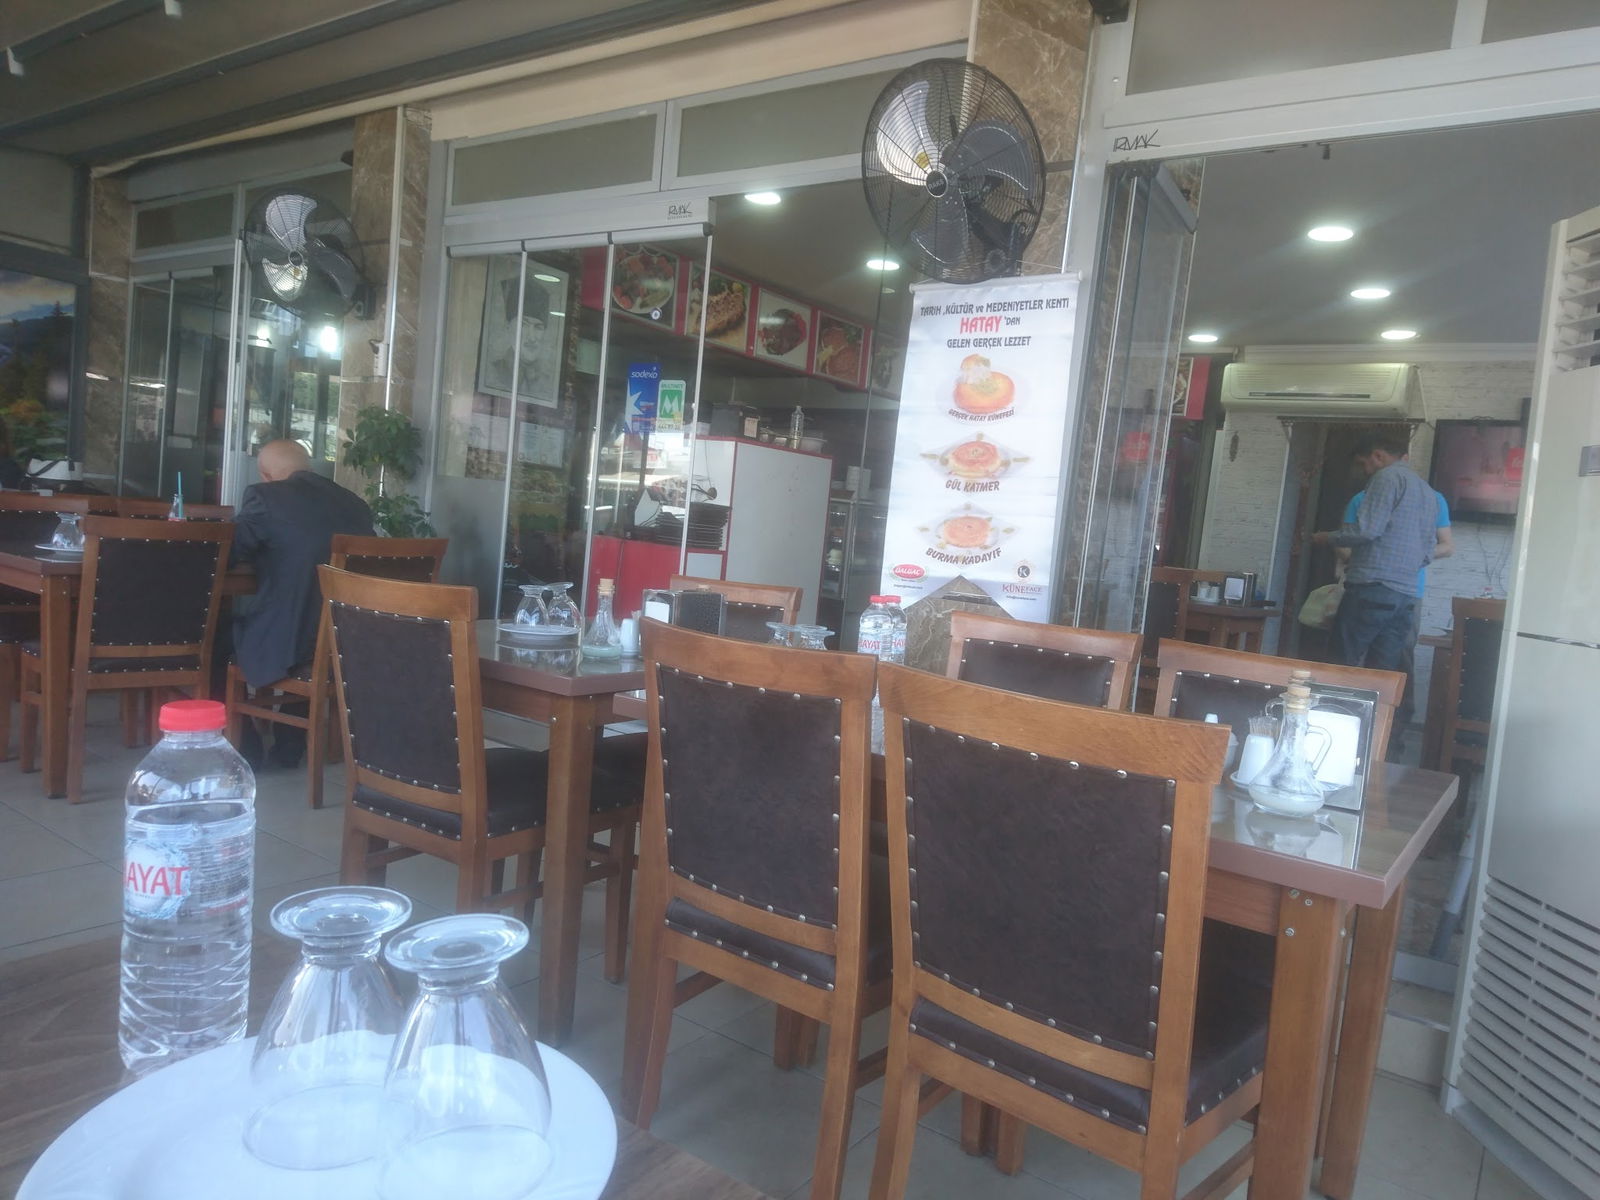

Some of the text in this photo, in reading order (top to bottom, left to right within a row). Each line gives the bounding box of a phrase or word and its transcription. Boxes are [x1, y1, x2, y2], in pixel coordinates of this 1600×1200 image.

[976, 305, 985, 313] ve
[960, 315, 1002, 334] HATAY
[946, 335, 1032, 349] GELEN GERÇEK LEZZET
[631, 369, 658, 379] sodexo
[945, 479, 1000, 493] GÜL KATMER
[926, 547, 1002, 565] BURMA KADAYIF
[124, 862, 192, 896] AYAT
